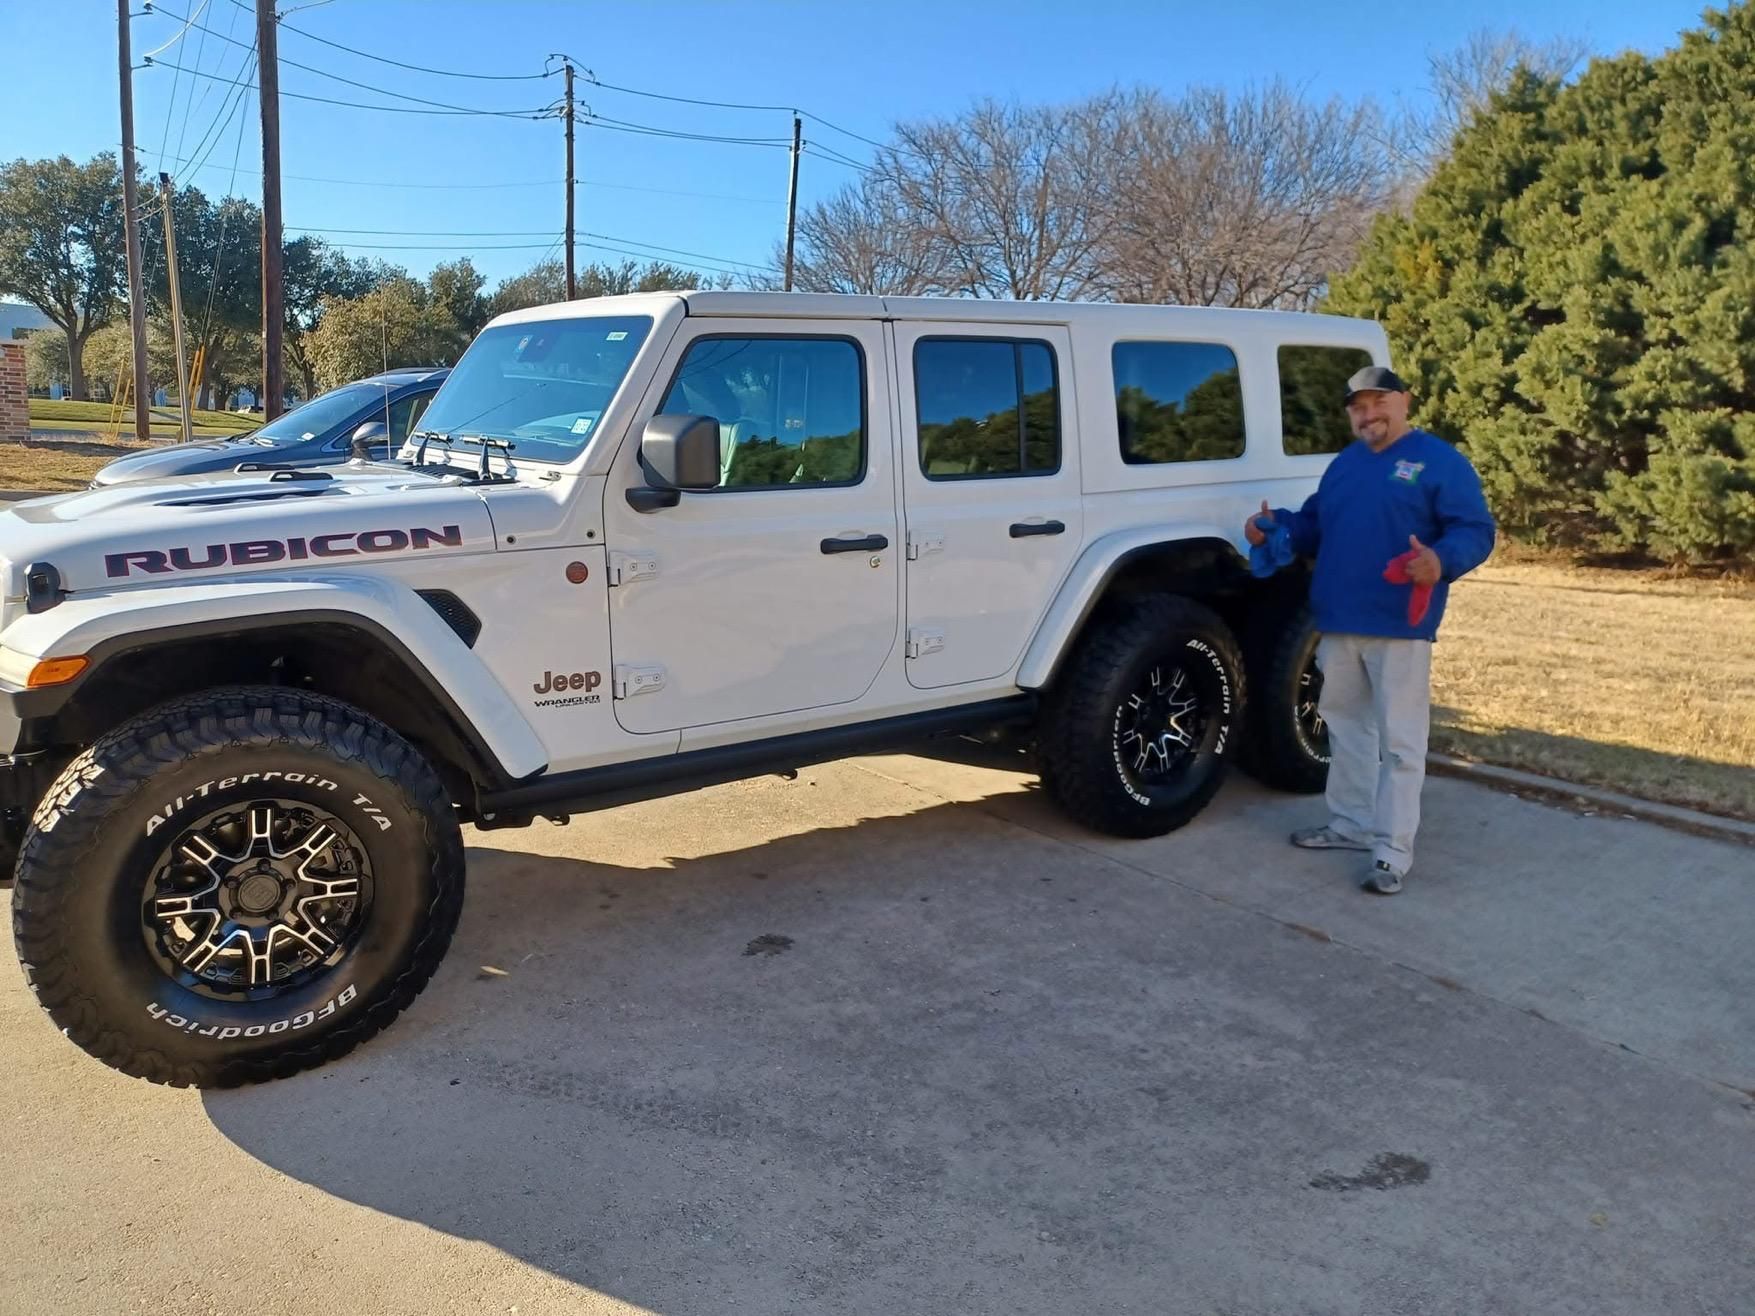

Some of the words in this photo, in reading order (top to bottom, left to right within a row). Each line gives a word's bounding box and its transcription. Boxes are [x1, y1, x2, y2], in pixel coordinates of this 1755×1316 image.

[104, 525, 463, 578] RUBICON
[533, 670, 602, 694] Jeep
[534, 695, 600, 707] WRANGLER
[1186, 638, 1231, 714] All-Terrain
[1214, 725, 1229, 754] T/A
[1112, 705, 1151, 806] BFGoodrich
[146, 770, 339, 837] All-Terrain
[352, 792, 393, 832] T/A
[145, 983, 358, 1040] BFGoodrich
